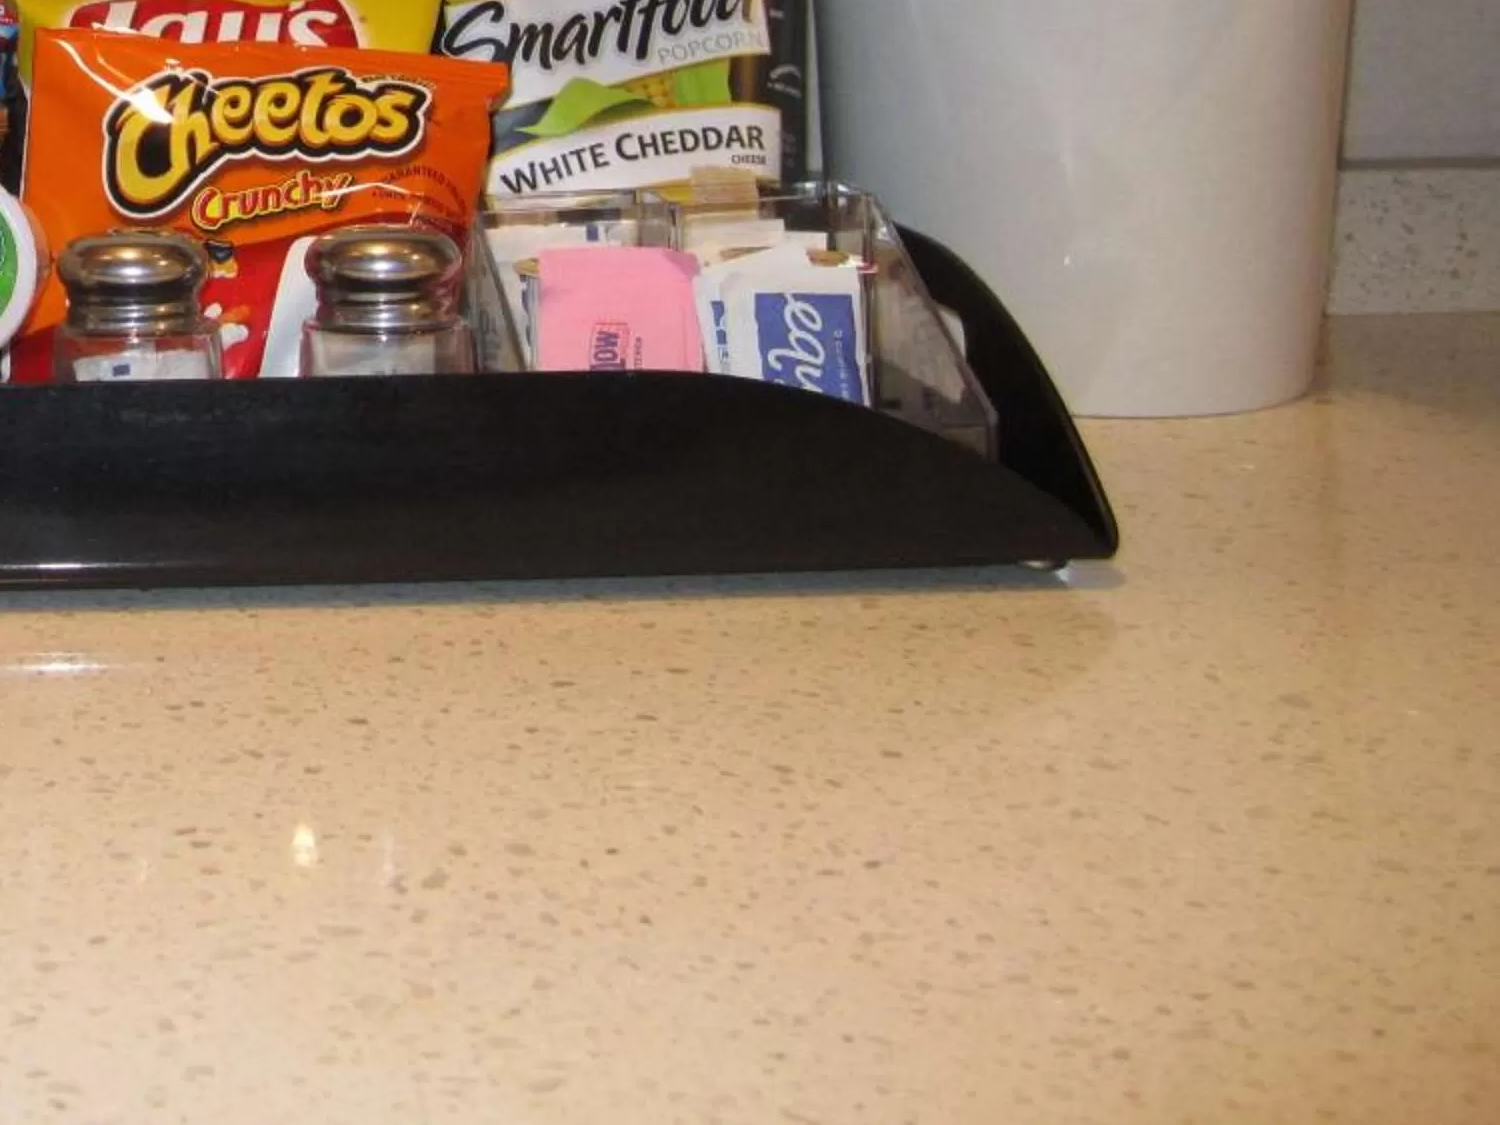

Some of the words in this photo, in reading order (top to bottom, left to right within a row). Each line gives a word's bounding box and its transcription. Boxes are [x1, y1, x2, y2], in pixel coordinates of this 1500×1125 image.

[657, 29, 765, 65] POPCORN
[112, 70, 420, 210] Cheetos
[500, 142, 610, 194] WHITE
[615, 124, 765, 162] CHEDDAR
[197, 170, 350, 227] Crunchy
[767, 293, 826, 393] equ
